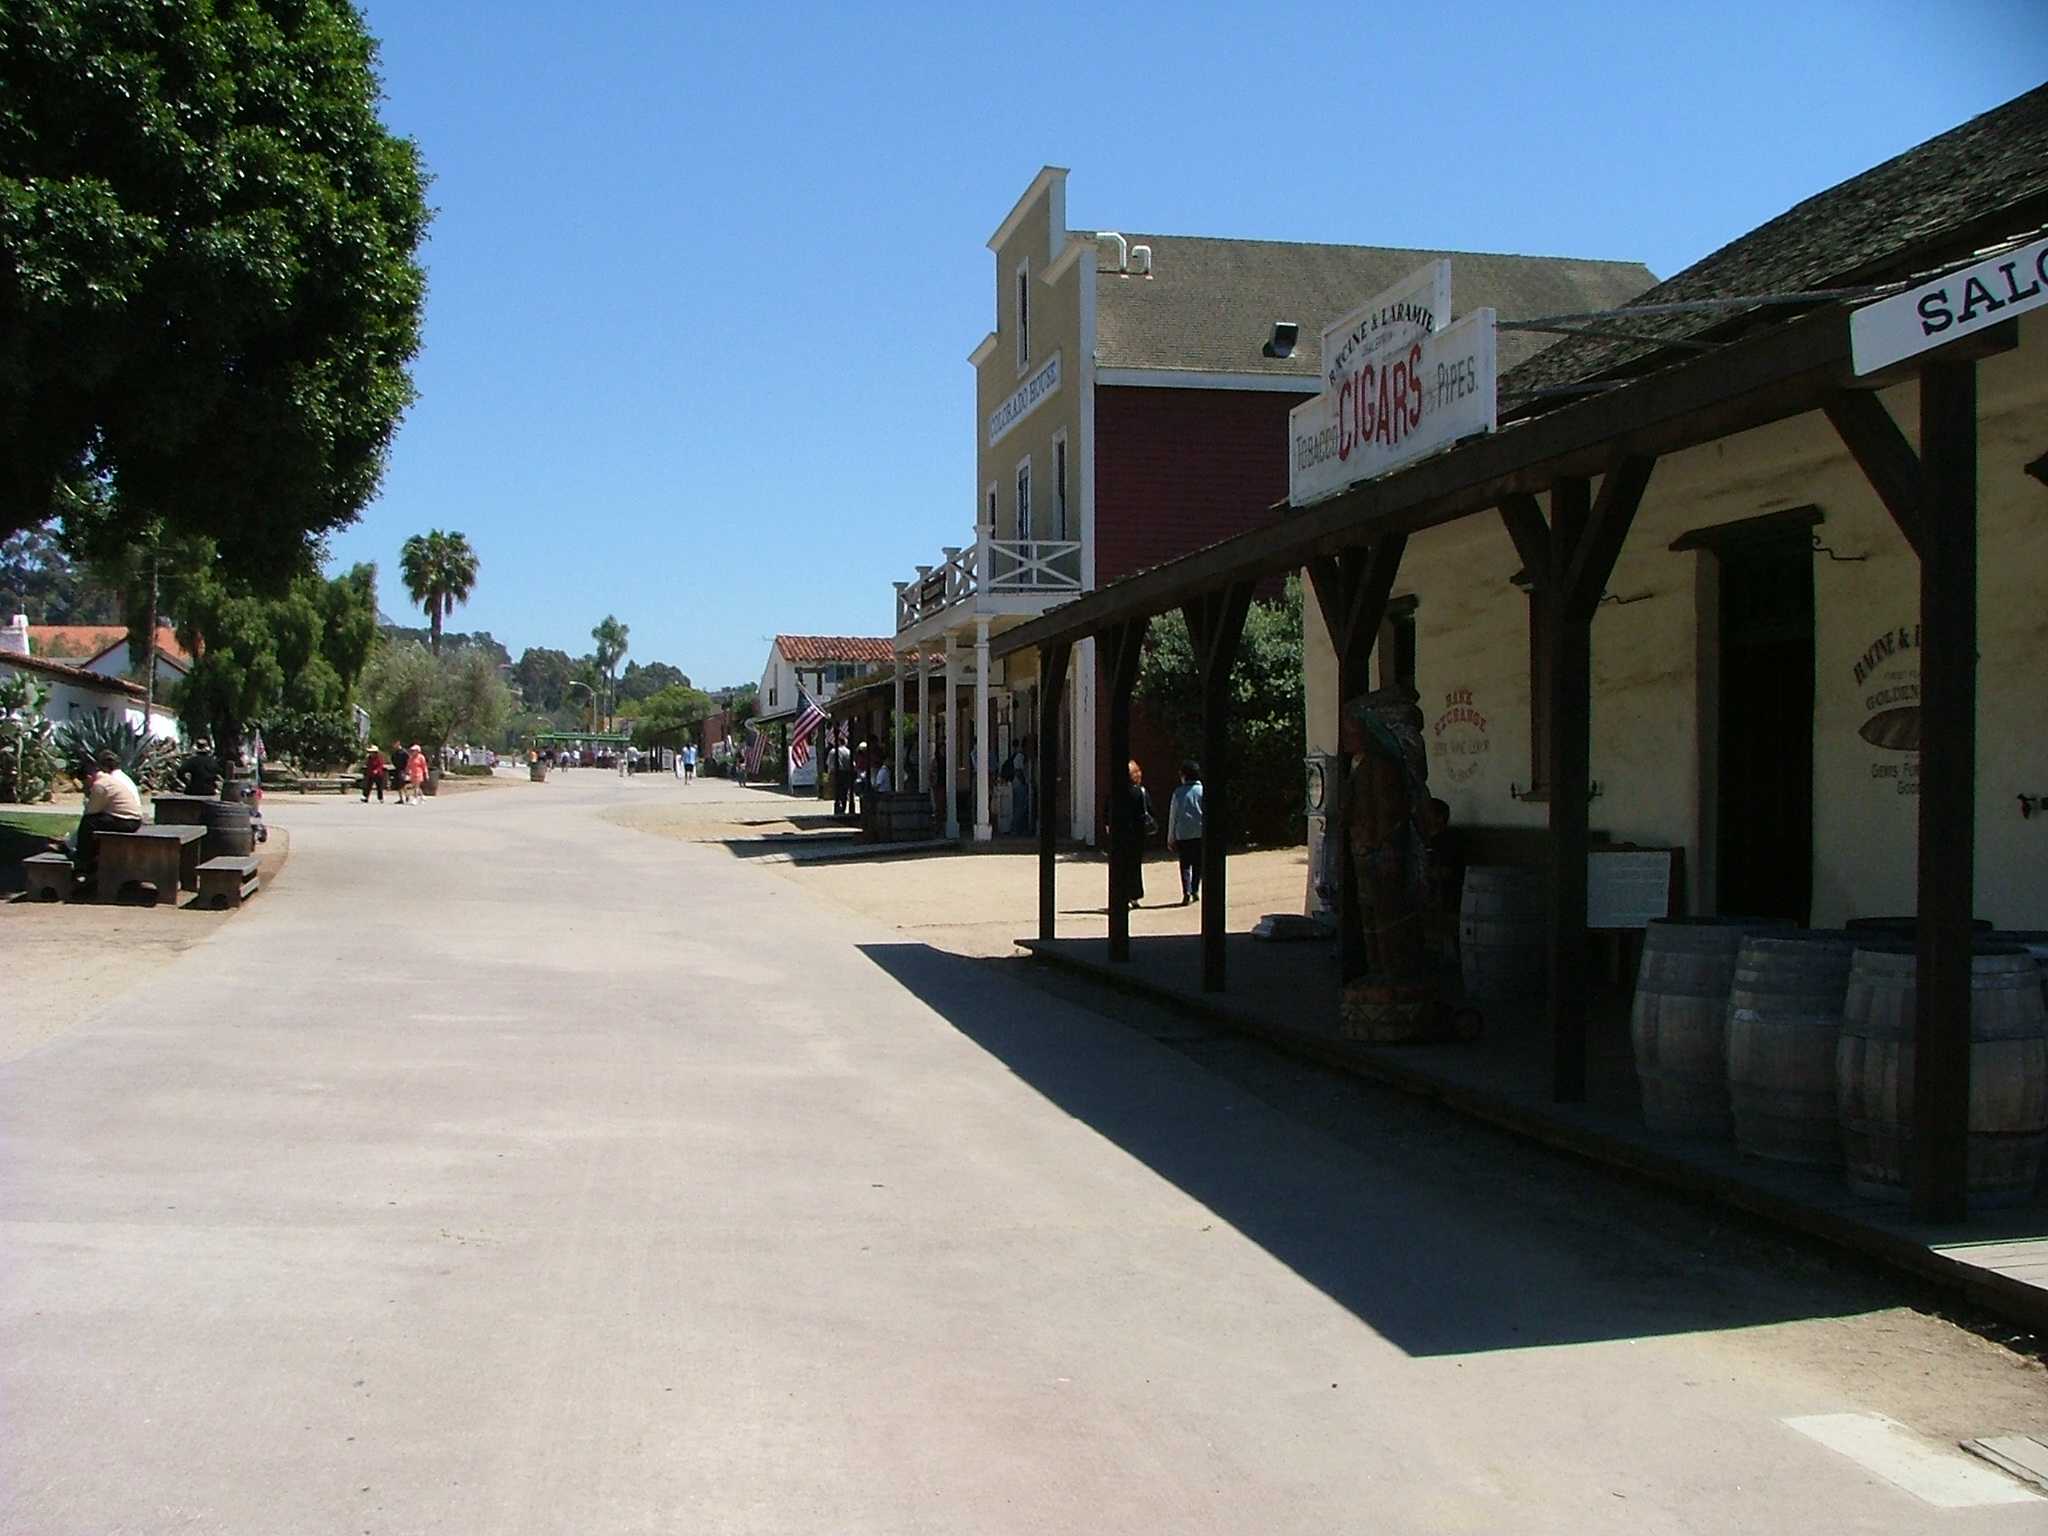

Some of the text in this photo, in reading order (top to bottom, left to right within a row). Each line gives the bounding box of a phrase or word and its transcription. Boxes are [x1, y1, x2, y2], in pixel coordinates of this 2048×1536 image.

[1381, 304, 1434, 333] LARAMIE
[991, 360, 1057, 438] COLORADO HOUSE
[1339, 344, 1422, 461] CIGARS
